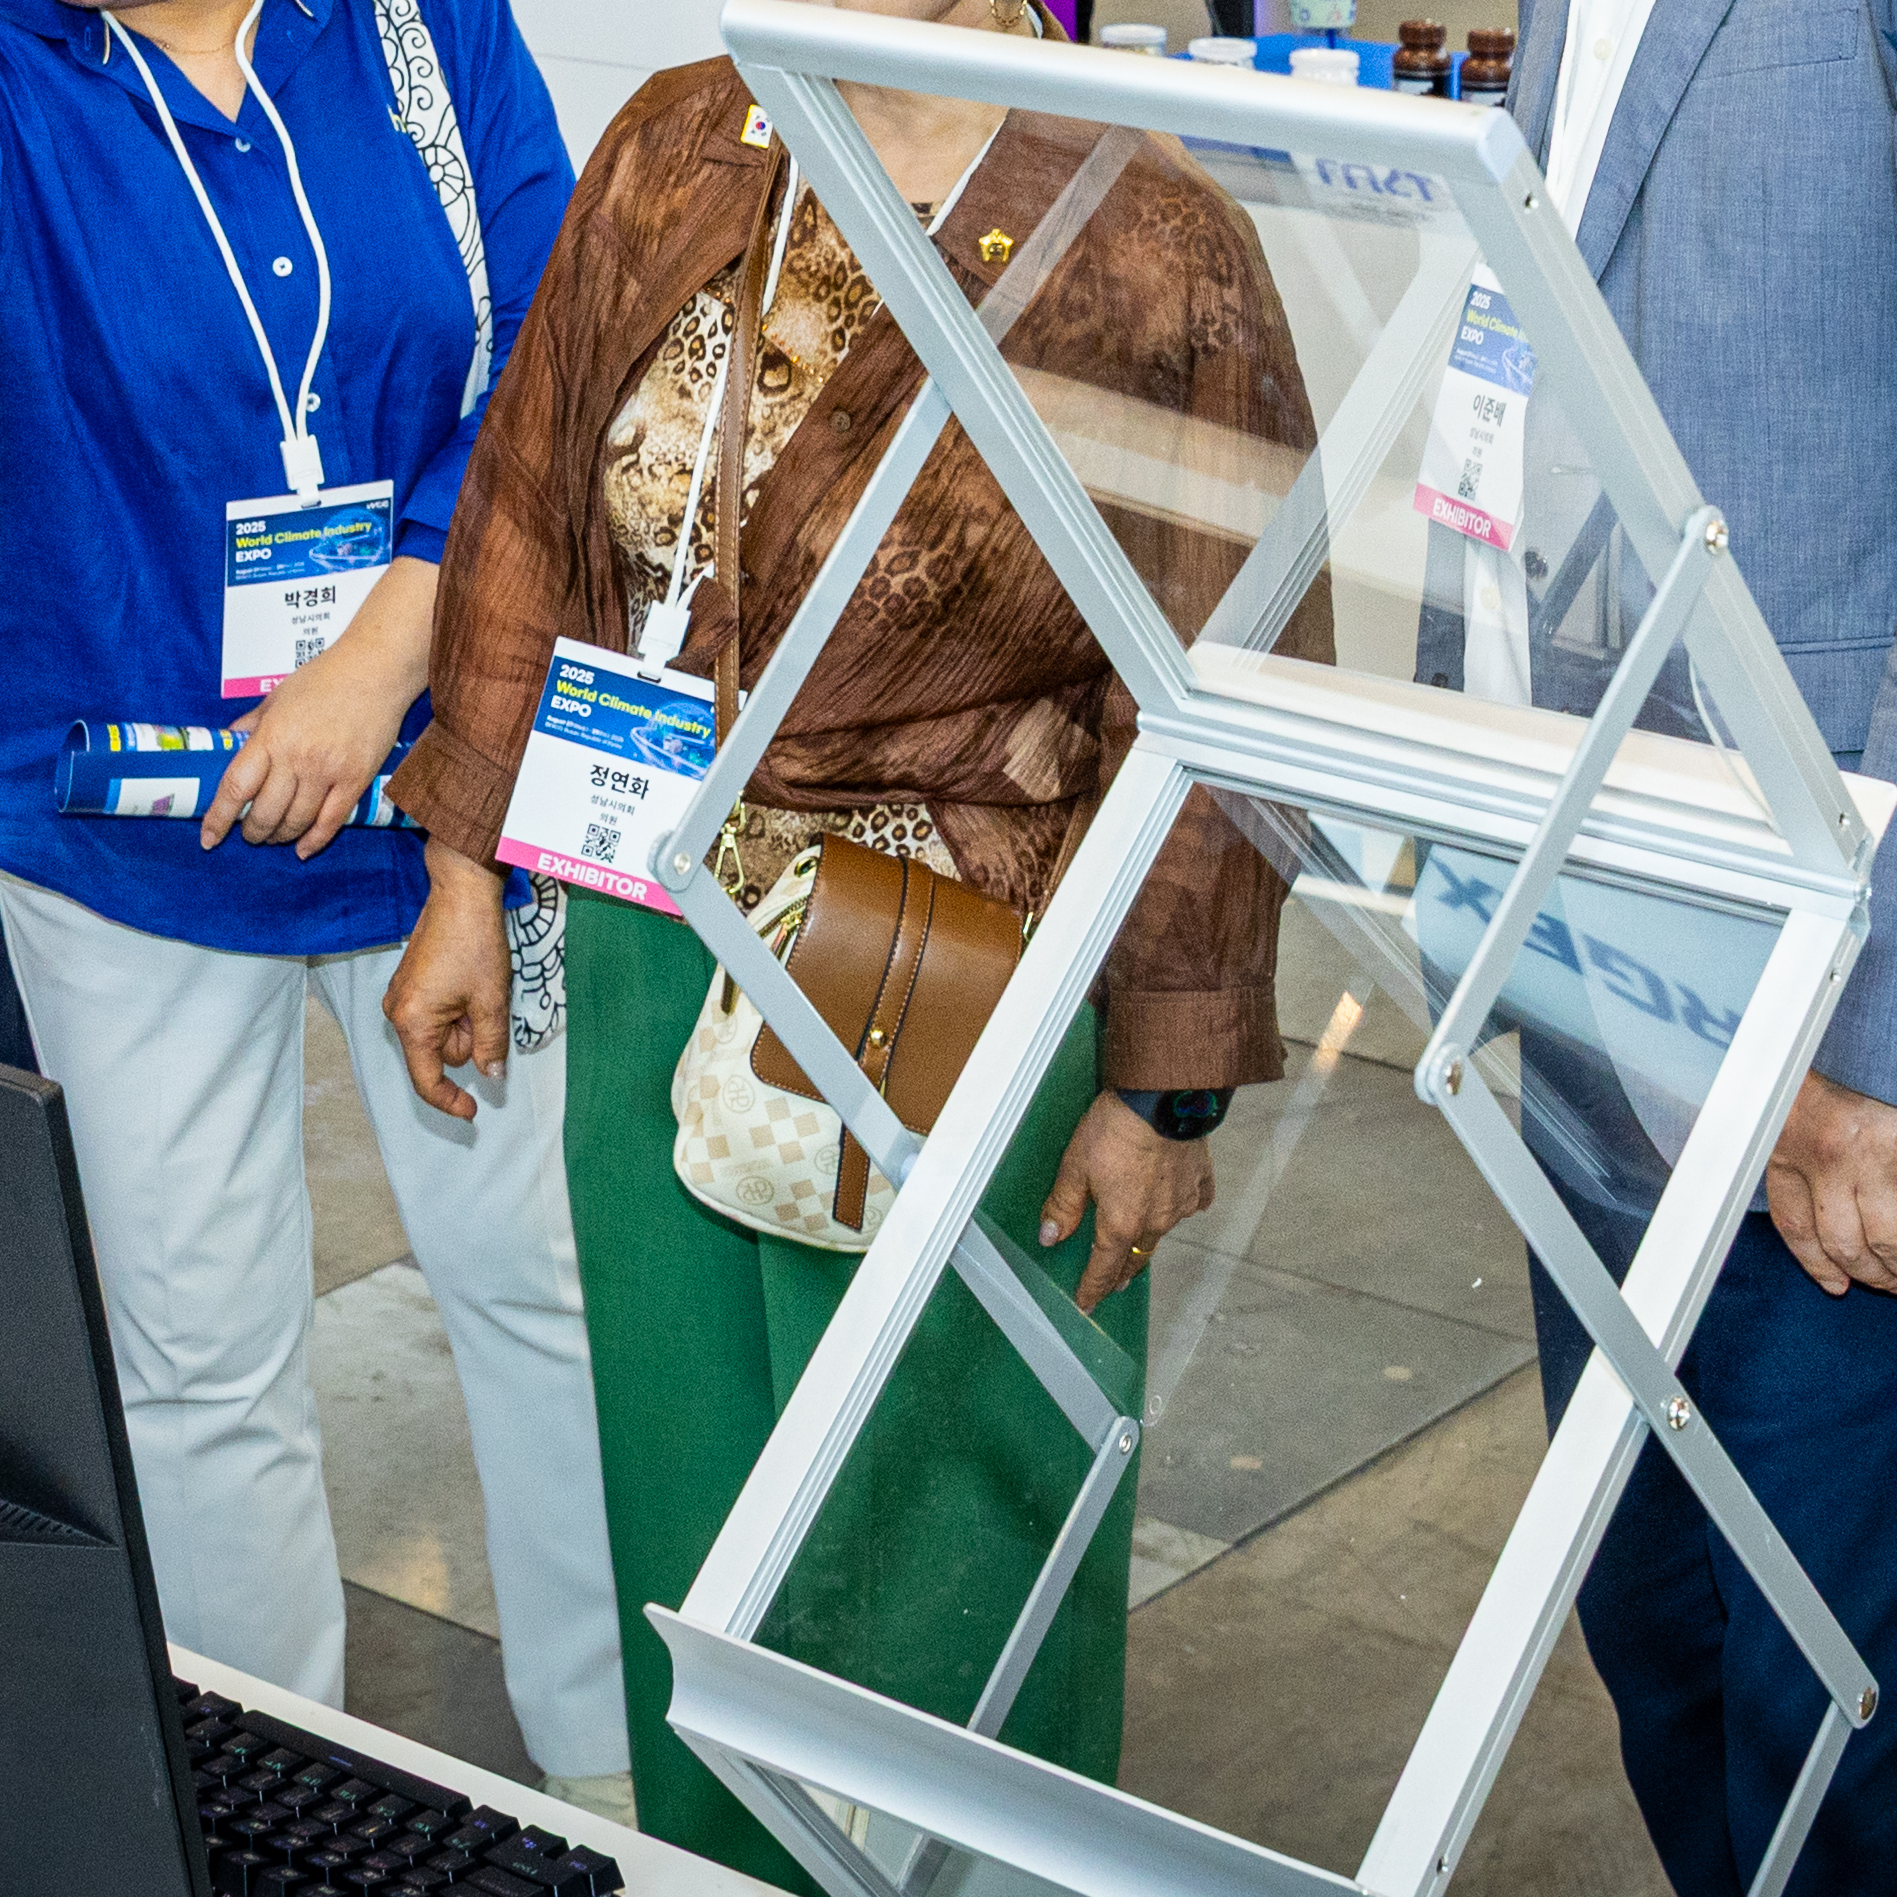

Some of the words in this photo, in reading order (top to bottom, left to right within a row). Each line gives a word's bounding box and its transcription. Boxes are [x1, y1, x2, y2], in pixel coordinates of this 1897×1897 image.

[1470, 291, 1491, 310] 2025
[1467, 309, 1489, 328] World
[1461, 325, 1483, 345] EXPO
[236, 521, 266, 535] 2025
[1433, 497, 1491, 538] EXHIBITOR
[236, 534, 272, 548] World
[275, 528, 320, 544] Climate
[323, 522, 372, 537] Industry
[236, 548, 271, 562] EXPO
[285, 585, 336, 609] 박경희
[560, 664, 594, 685] 2025
[551, 695, 592, 718] EXPO
[557, 680, 598, 703] World
[598, 693, 653, 719] Climate
[654, 710, 711, 739] Industry
[590, 764, 650, 800] 정연화
[599, 812, 618, 826] 의원
[537, 853, 648, 901] EXHIBITOR
